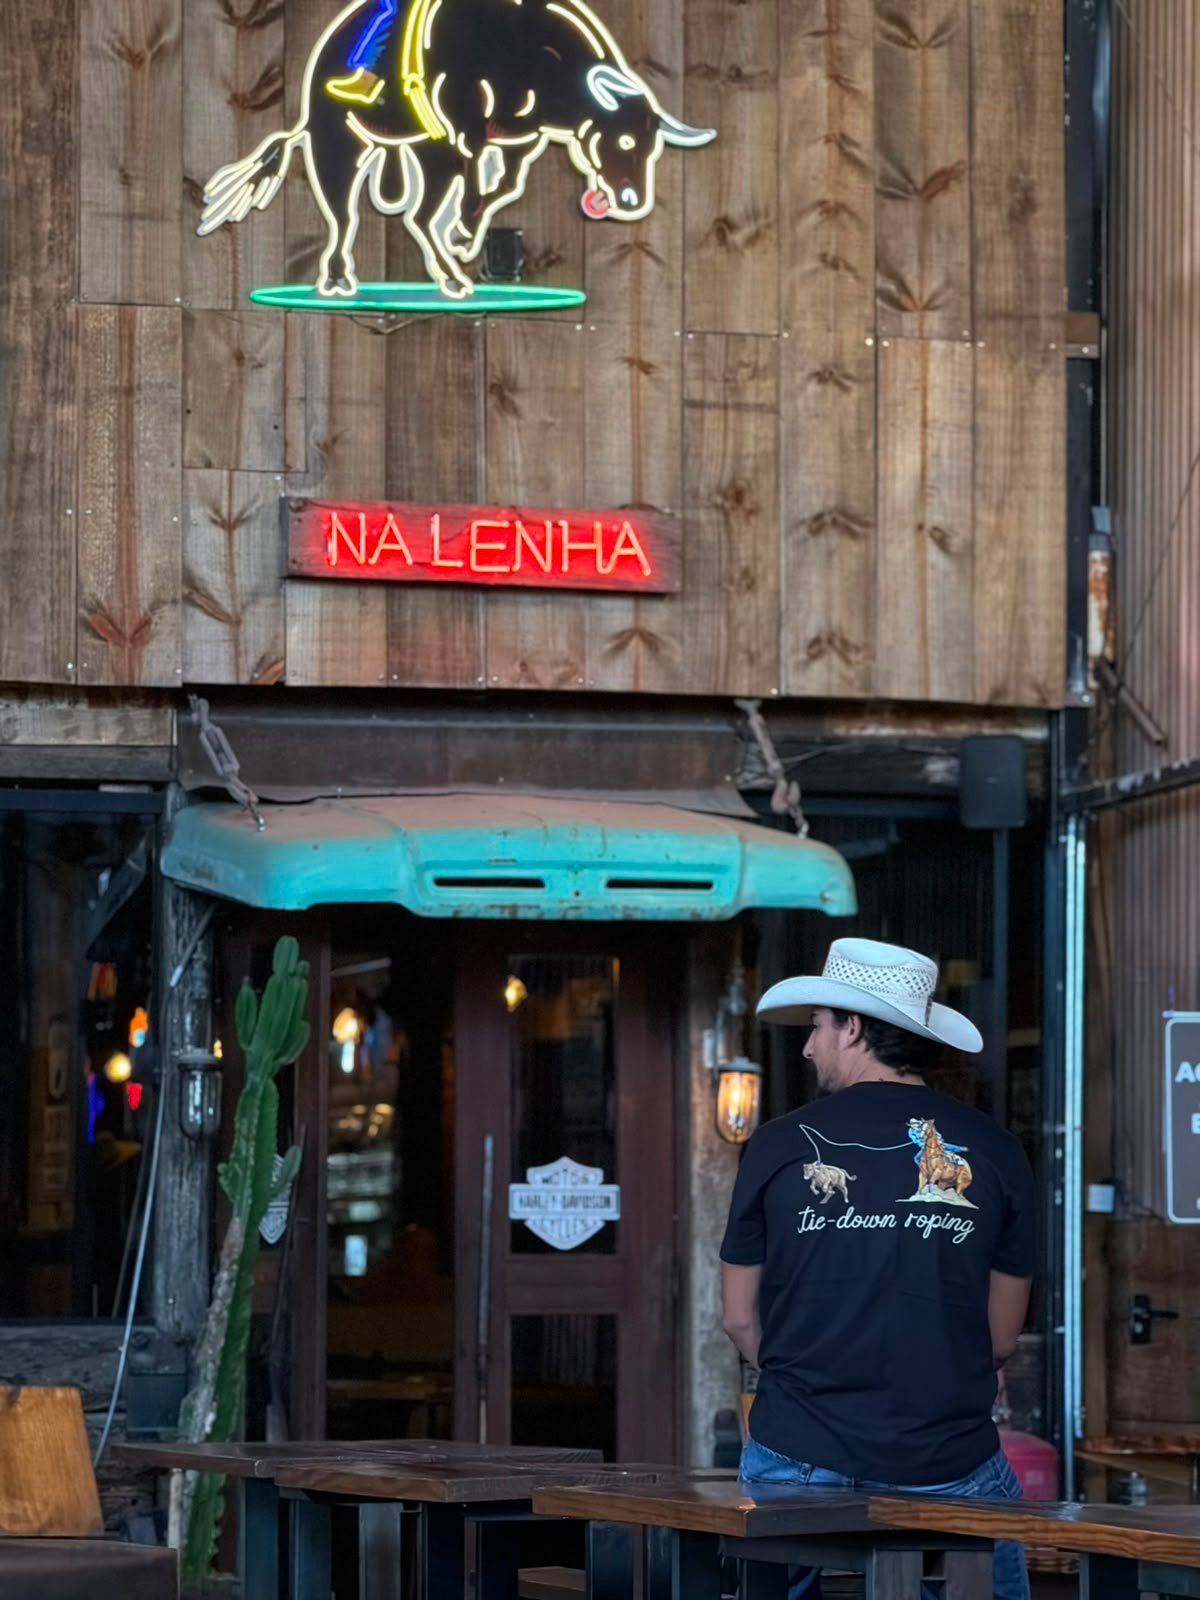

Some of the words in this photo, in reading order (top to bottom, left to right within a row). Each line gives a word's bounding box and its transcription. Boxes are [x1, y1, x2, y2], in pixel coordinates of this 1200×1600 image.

[329, 512, 413, 566] NA
[431, 512, 651, 576] LENHA
[797, 1205, 897, 1234] tie-down
[904, 1212, 975, 1244] roping
